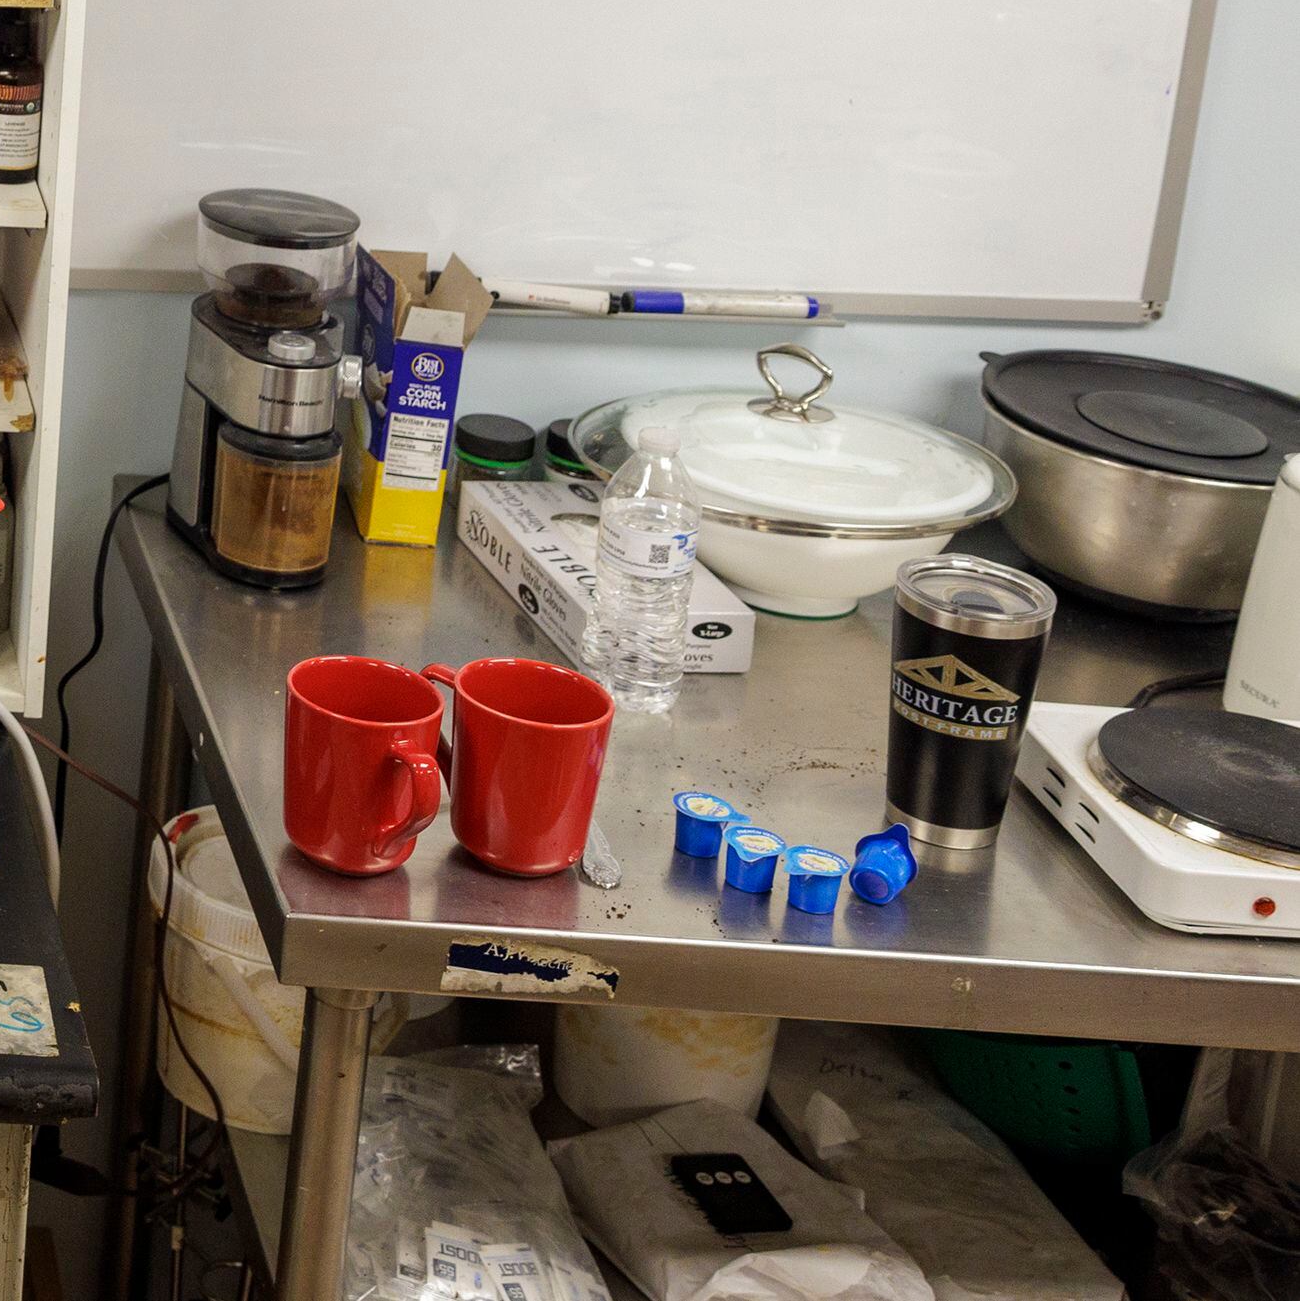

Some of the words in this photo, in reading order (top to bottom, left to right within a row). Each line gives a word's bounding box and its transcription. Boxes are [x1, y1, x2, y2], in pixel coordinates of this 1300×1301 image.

[406, 388, 442, 400] CORN
[398, 396, 446, 411] STARCH
[393, 416, 424, 426] Nutrition
[426, 418, 446, 428] Facts
[892, 671, 1018, 725] HERITAGE
[936, 722, 1008, 739] FRAME
[439, 1242, 482, 1265] OOST
[500, 1262, 539, 1277] BOOST
